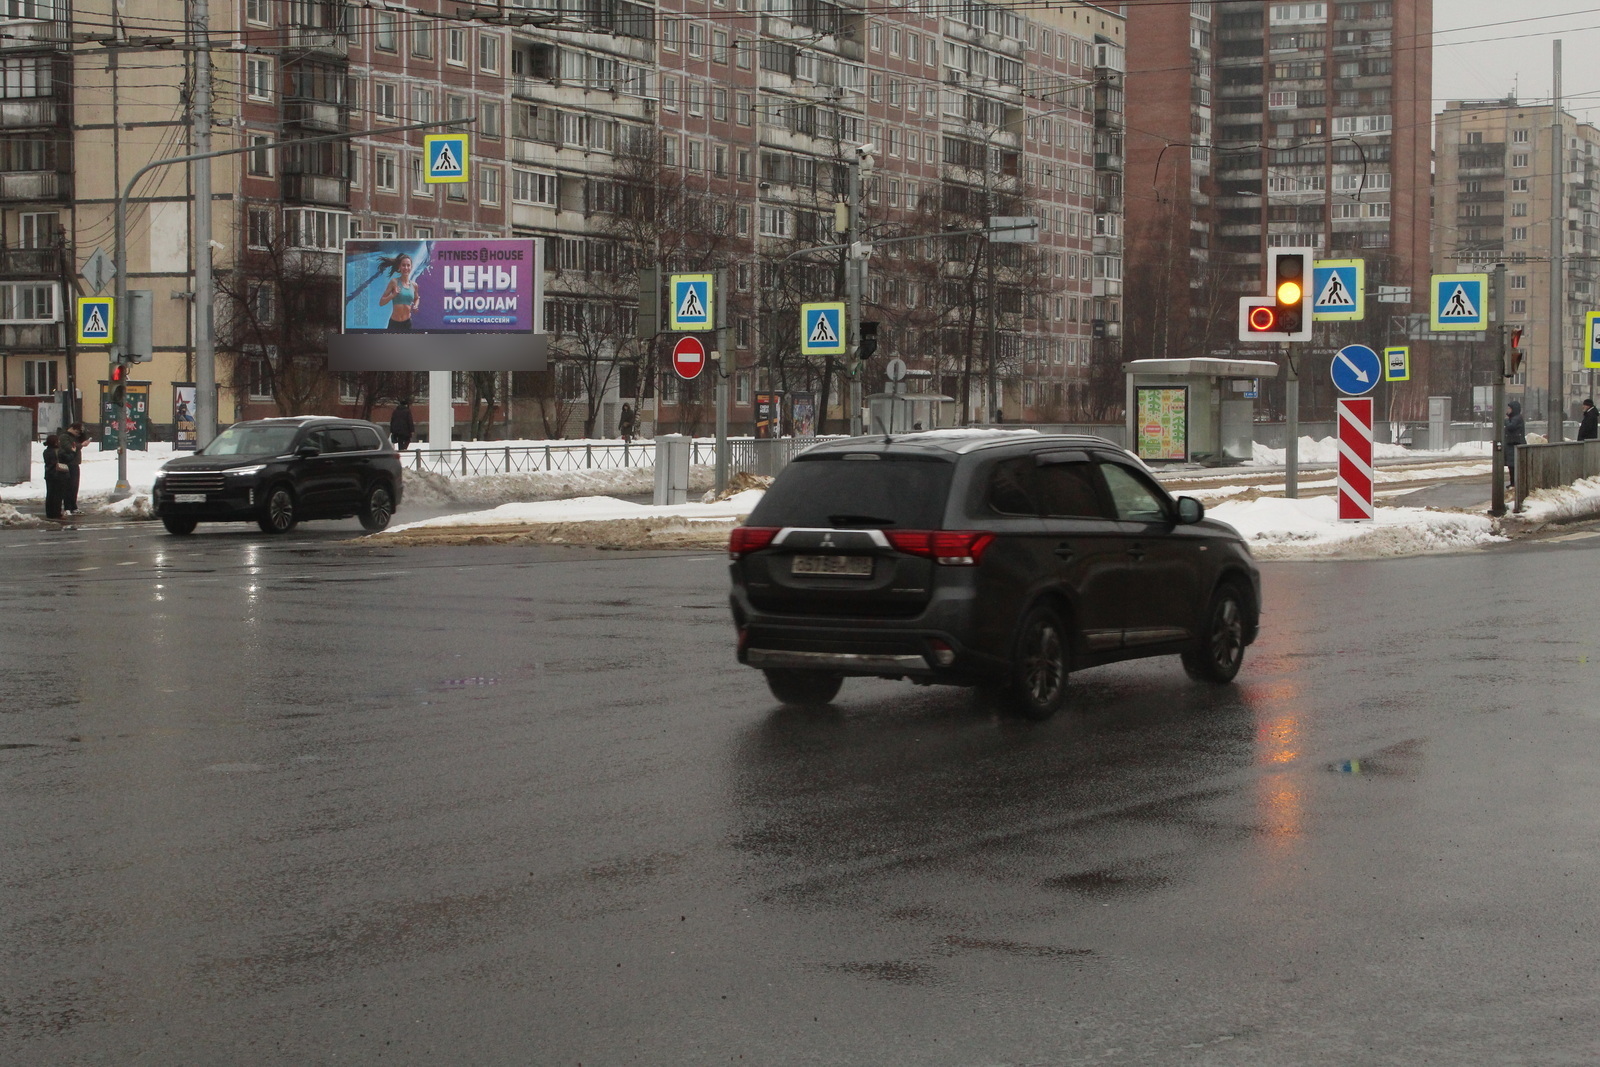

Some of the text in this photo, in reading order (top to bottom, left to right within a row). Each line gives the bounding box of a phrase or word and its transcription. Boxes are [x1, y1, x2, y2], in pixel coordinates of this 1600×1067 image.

[438, 250, 524, 260] FITNESS HOUSE
[444, 265, 517, 294] ЦЕНЫ
[444, 296, 517, 310] ПОПОЛАМ
